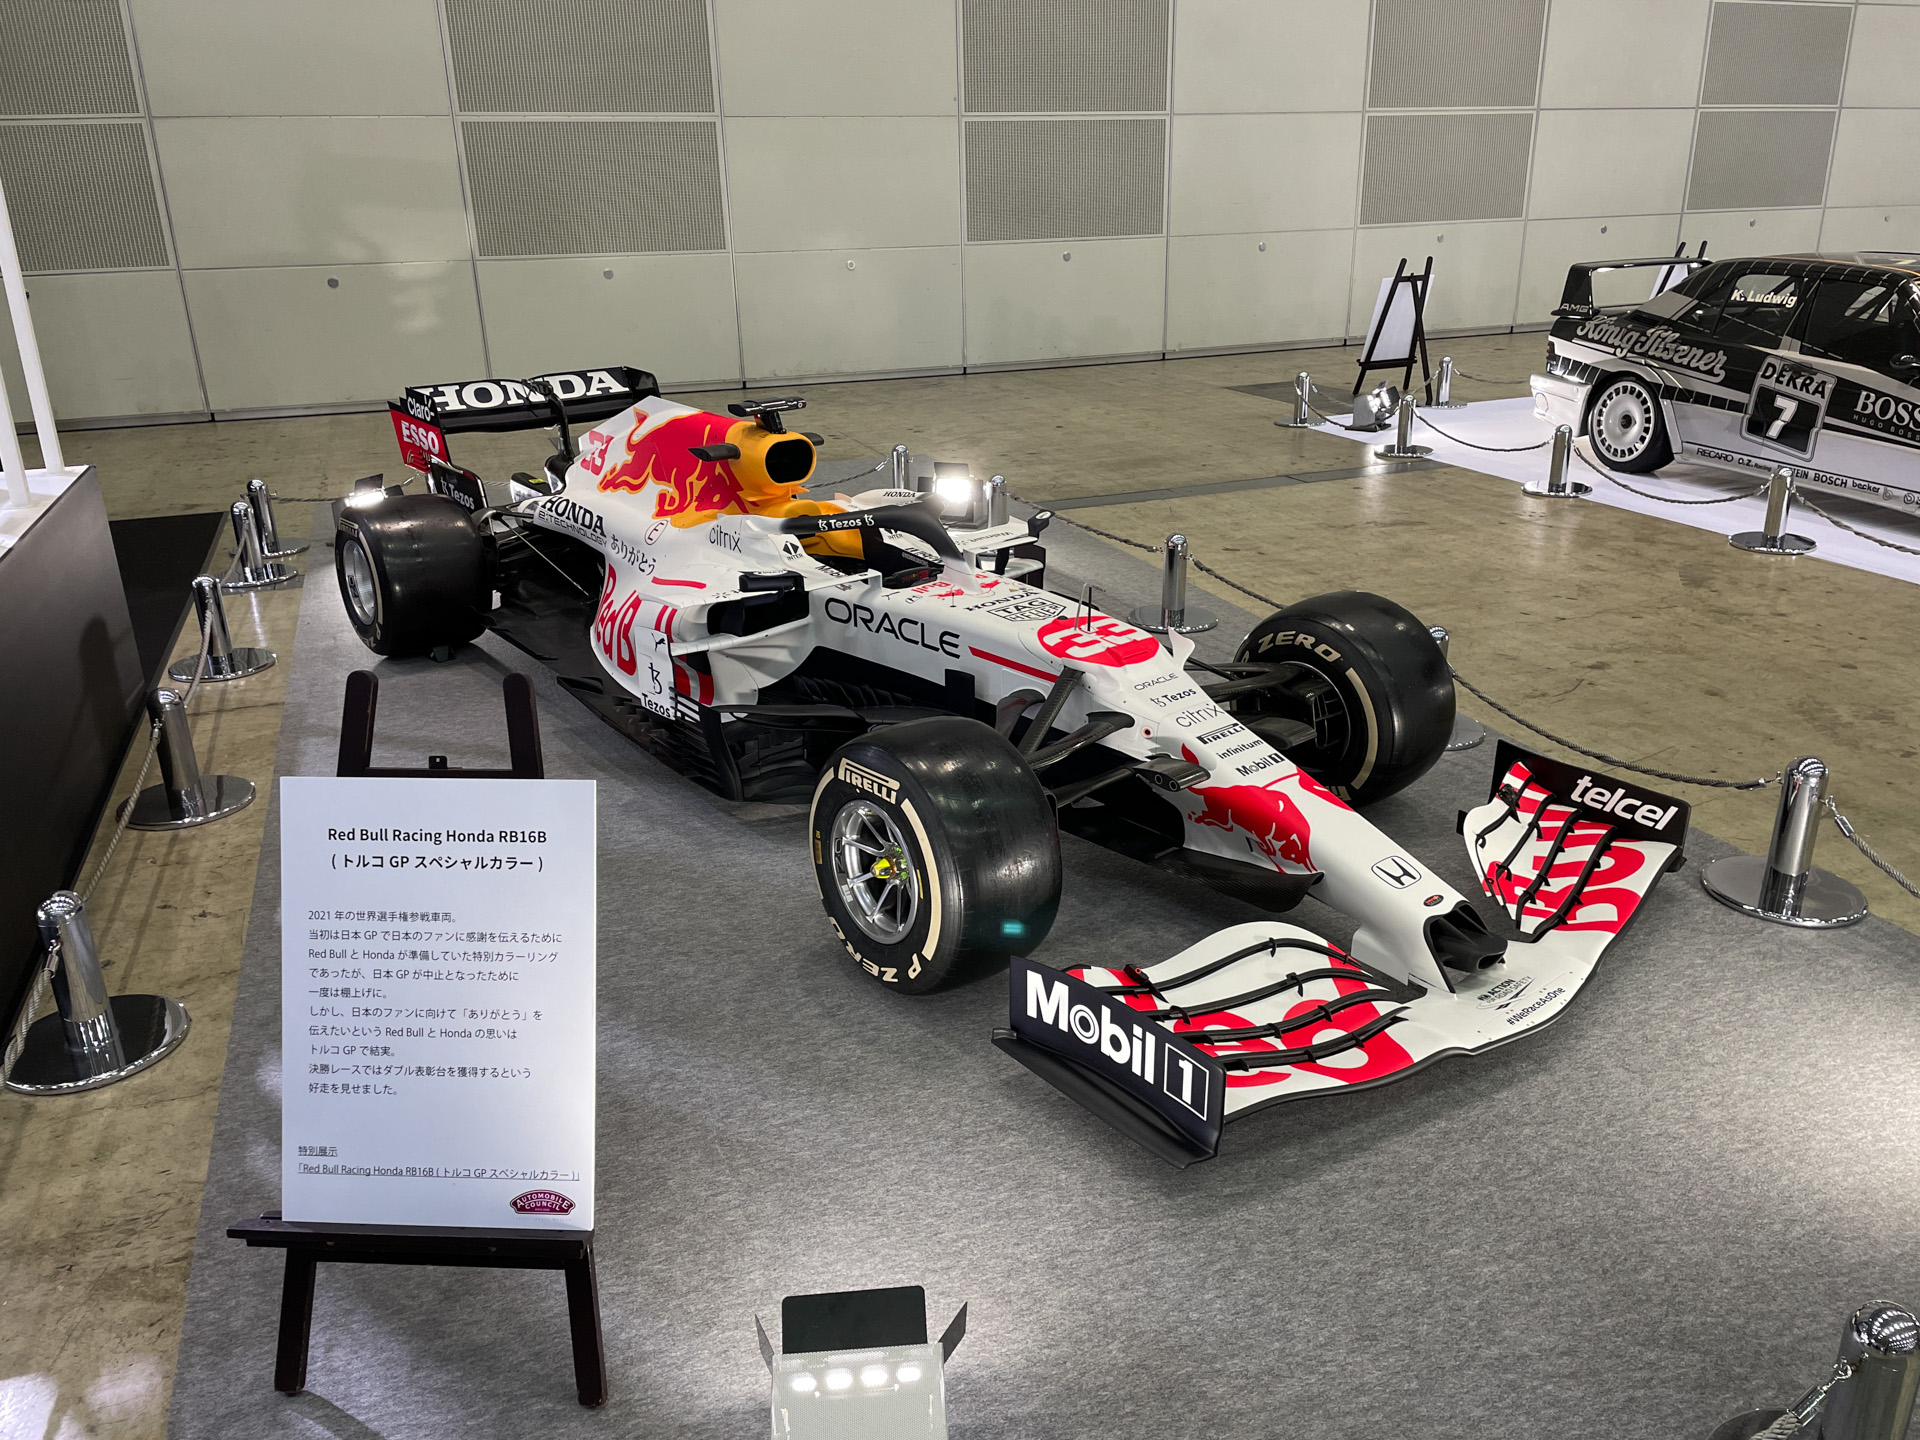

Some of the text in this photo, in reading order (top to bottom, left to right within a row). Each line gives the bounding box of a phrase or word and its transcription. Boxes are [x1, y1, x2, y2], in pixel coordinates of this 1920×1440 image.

[1560, 302, 1590, 313] AMG
[1730, 289, 1798, 309] K. Ludwig
[412, 370, 630, 411] HONDA
[1759, 361, 1829, 400] DEKRA
[406, 396, 432, 422] Claro
[1765, 394, 1799, 440] 7
[1853, 389, 1920, 433] BOSS
[400, 419, 440, 455] ESSO
[1853, 413, 1920, 441] HUGO BOSS
[1696, 446, 1735, 463] RECARO
[1812, 471, 1849, 489] BOSCH
[1851, 479, 1881, 494] becker
[448, 482, 475, 511] Tezos
[882, 490, 917, 498] HONDA
[540, 495, 608, 539] HONDA
[829, 517, 863, 530] Tezos
[708, 524, 743, 554] citrix
[610, 533, 657, 577] ありがとう
[963, 588, 1040, 612] HONDA
[998, 600, 1048, 615] TAG
[823, 597, 962, 659] ORACLE
[1258, 630, 1342, 663] ZERO
[1133, 672, 1180, 692] ORACLE
[641, 692, 672, 719] Tezos
[1162, 687, 1197, 704] Tezos
[1175, 703, 1226, 729] citrix
[1195, 722, 1246, 745] PIRELLI
[1215, 738, 1264, 760] infinitum
[1235, 756, 1274, 778] Mobil
[837, 756, 901, 805] PIRELLI
[1569, 774, 1679, 831] telcel
[327, 827, 547, 845] Red Bull Racing Honda RB16B
[388, 855, 409, 868] GP
[308, 909, 455, 923] 2021 年の世界選手権参戦車両。
[308, 928, 562, 943] 当初は日本 GP で日本のファンに感謝を伝えるために
[308, 948, 326, 958] Red
[329, 948, 347, 958] Bull
[362, 949, 394, 959] Honda
[397, 949, 558, 962] が準備していた特別カラーリング
[828, 916, 922, 983] P ZERO
[395, 969, 409, 979] GP
[412, 968, 518, 981] が中止となったために
[308, 986, 386, 998] 一度は棚上げに。
[1505, 986, 1567, 1026] #WeRaceAsOne
[308, 1024, 381, 1036] 伝えたいという
[385, 1026, 403, 1037] Red
[406, 1027, 424, 1037] Bull
[439, 1028, 471, 1038] Honda
[474, 1028, 517, 1039] の思いは
[1026, 969, 1156, 1085] Mobil
[310, 1043, 394, 1056] トルコ GP で結実。
[308, 1063, 530, 1078] 決勝レースではダブル表彰台を獲得するという
[308, 1082, 397, 1095] 好走を見せました。
[297, 1145, 338, 1157] 特別展示
[322, 1164, 339, 1175] Bull
[341, 1164, 371, 1177] Racing
[373, 1165, 403, 1177] Honda
[405, 1166, 434, 1178] RB16B
[473, 1168, 487, 1179] GP
[516, 1192, 571, 1210] AUTOMOBILE
[524, 1200, 561, 1211] COUNCIL
